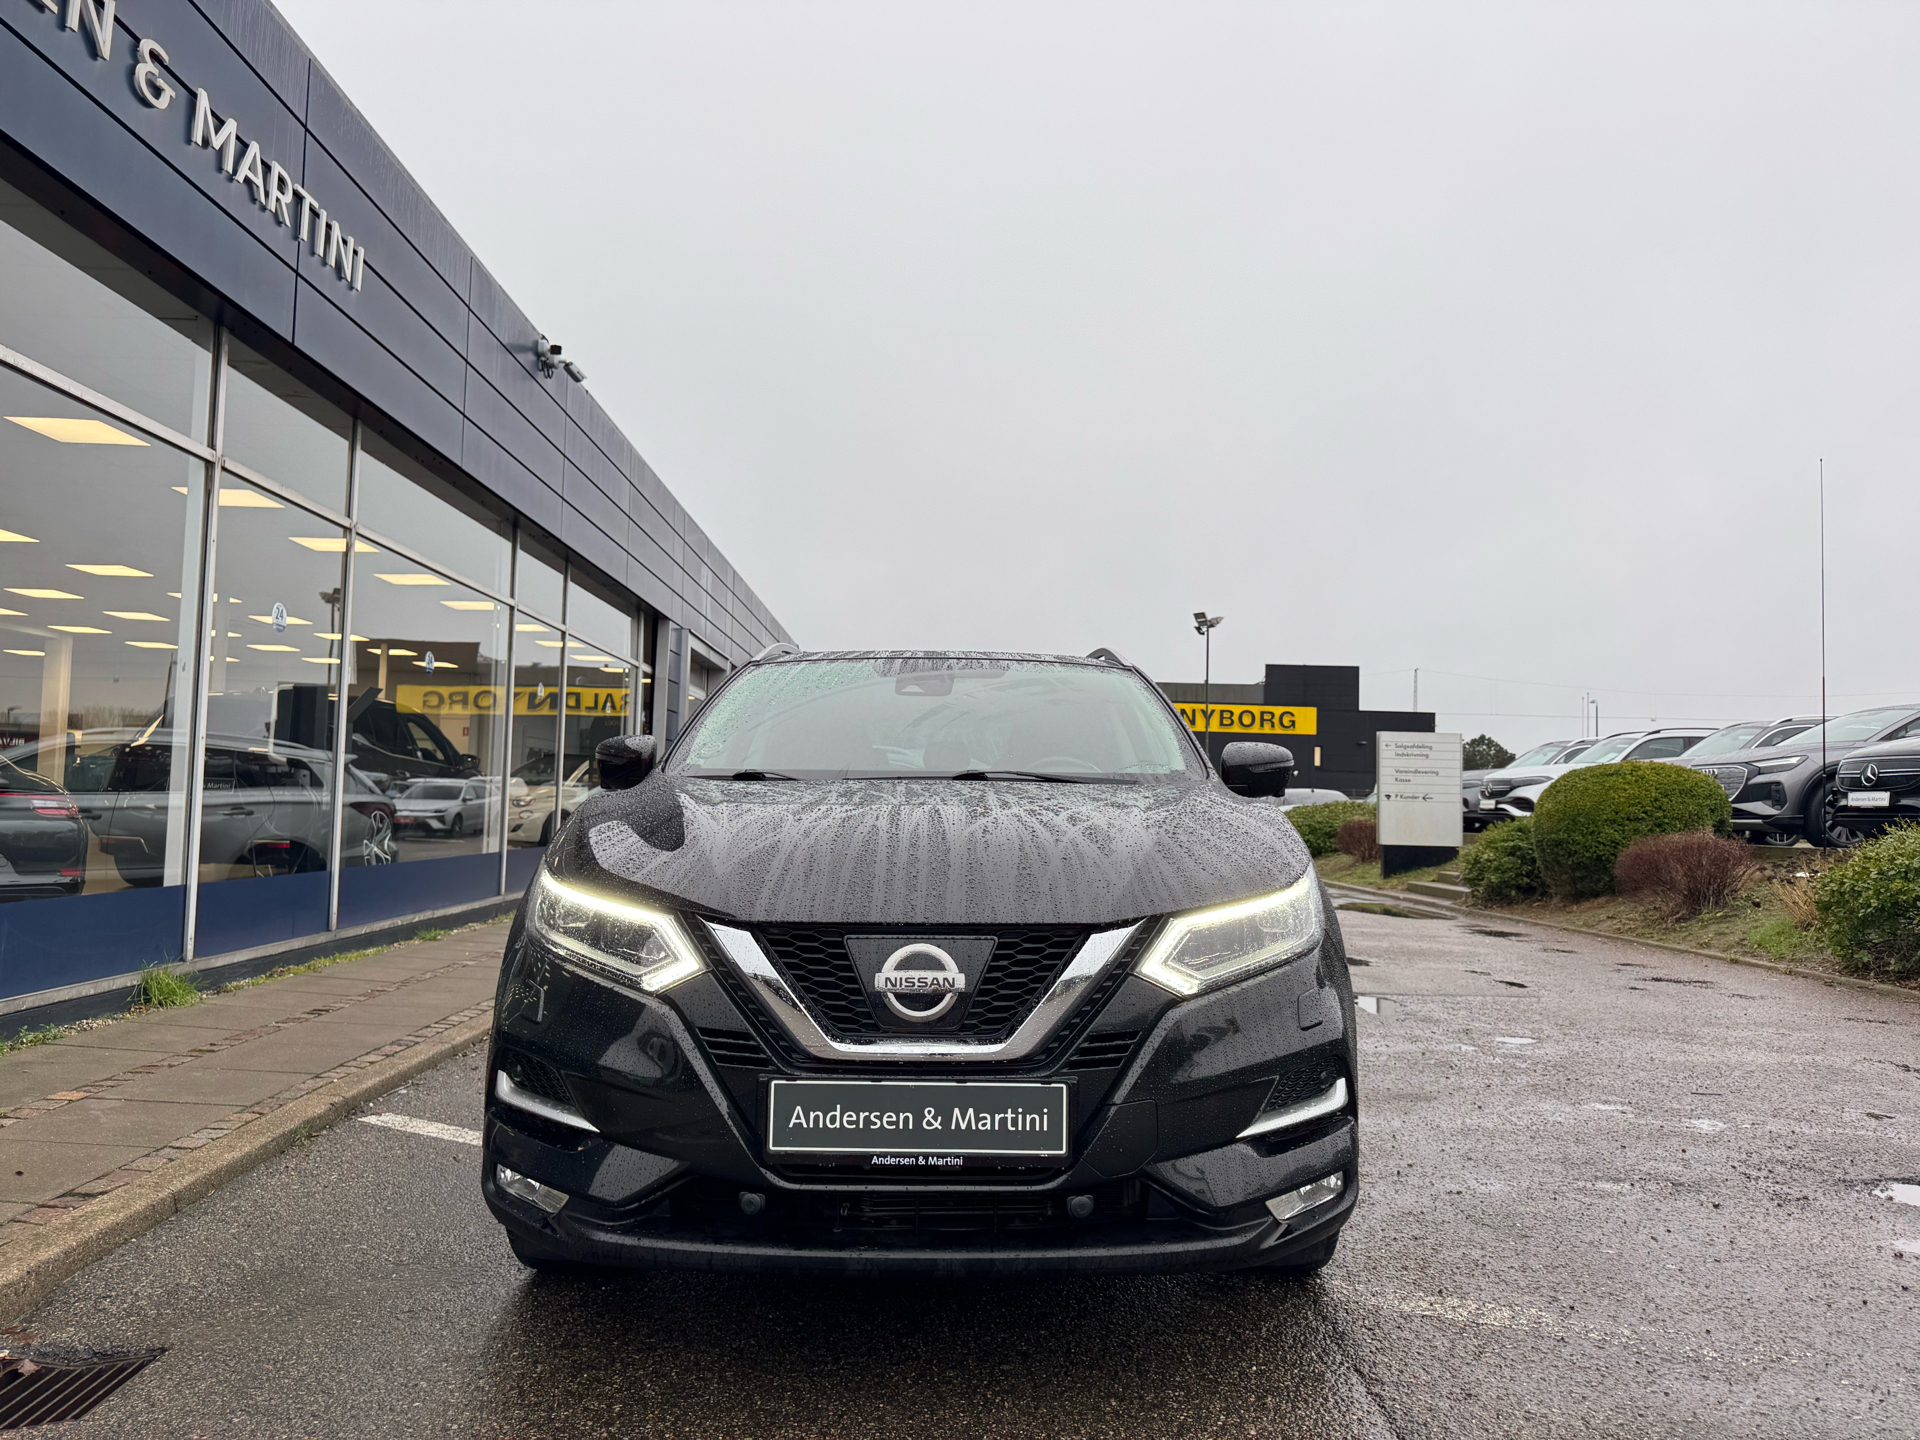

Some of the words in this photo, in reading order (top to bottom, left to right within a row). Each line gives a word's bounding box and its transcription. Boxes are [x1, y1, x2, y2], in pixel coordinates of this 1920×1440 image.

[134, 38, 176, 110] &
[191, 87, 365, 292] MARTINI
[275, 606, 284, 621] 24
[1180, 708, 1296, 729] NYBORG
[884, 976, 955, 988] NISSAN
[788, 1104, 914, 1129] Andersen
[922, 1106, 942, 1130] &
[951, 1107, 1048, 1131] Martini
[871, 1155, 916, 1165] Andersen
[917, 1156, 926, 1165] &
[927, 1156, 963, 1166] Martini
